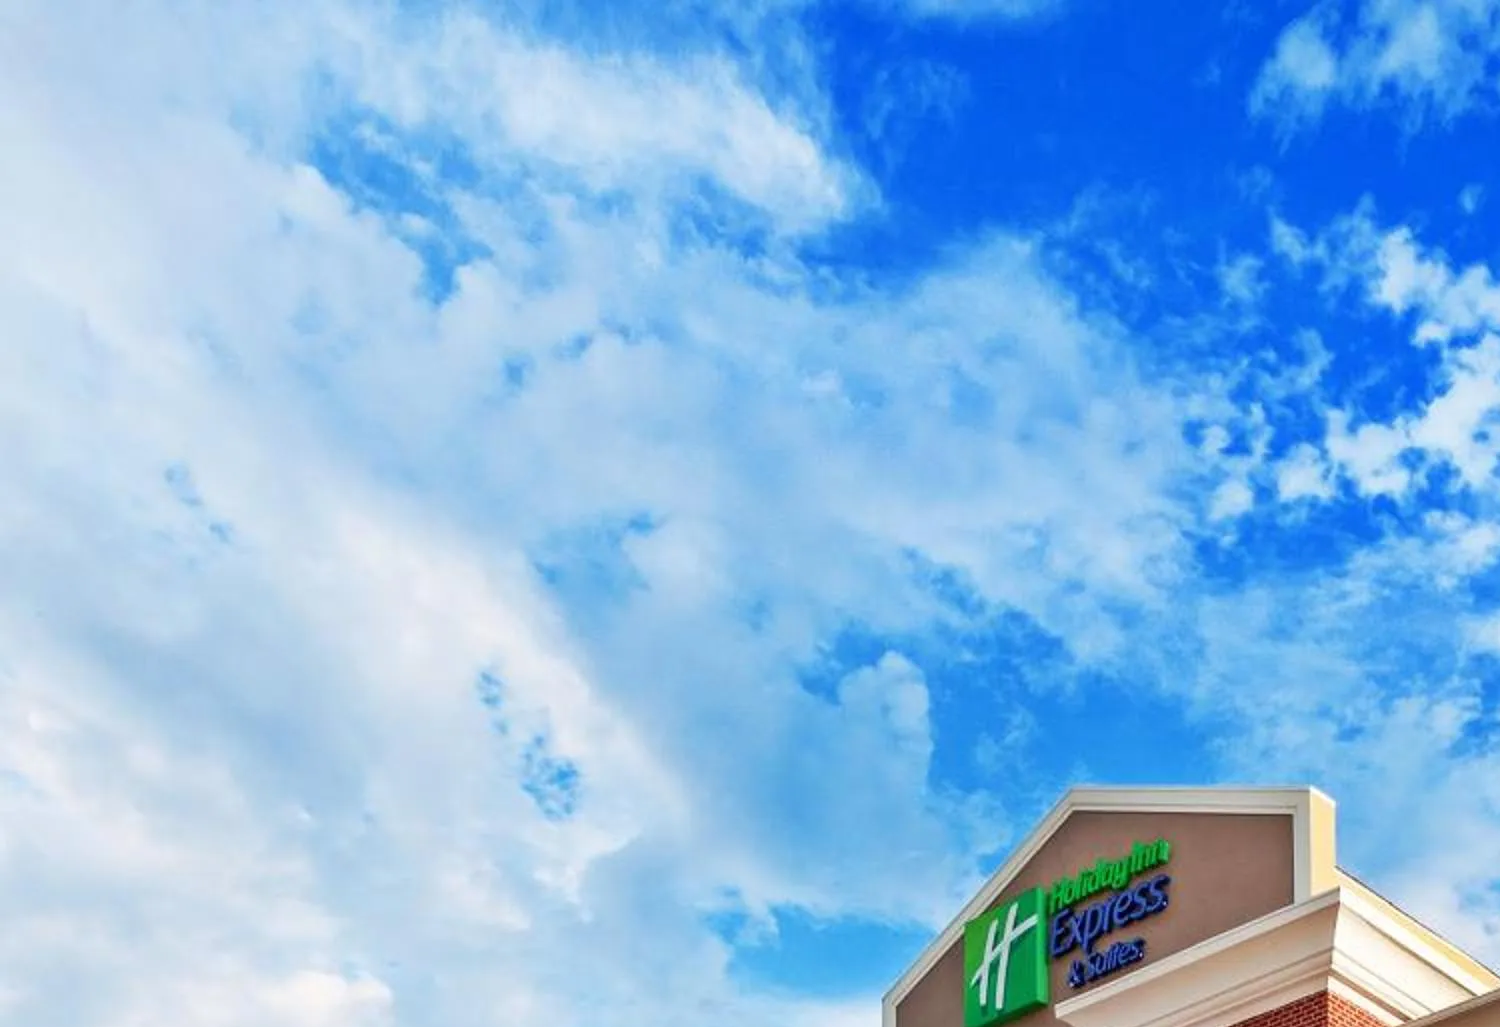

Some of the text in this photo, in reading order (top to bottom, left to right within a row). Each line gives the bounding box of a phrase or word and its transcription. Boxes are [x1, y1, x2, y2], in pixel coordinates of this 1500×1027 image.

[1051, 838, 1170, 908] Holiday Inn
[1052, 875, 1170, 957] Express
[1067, 938, 1145, 988] & Suites
